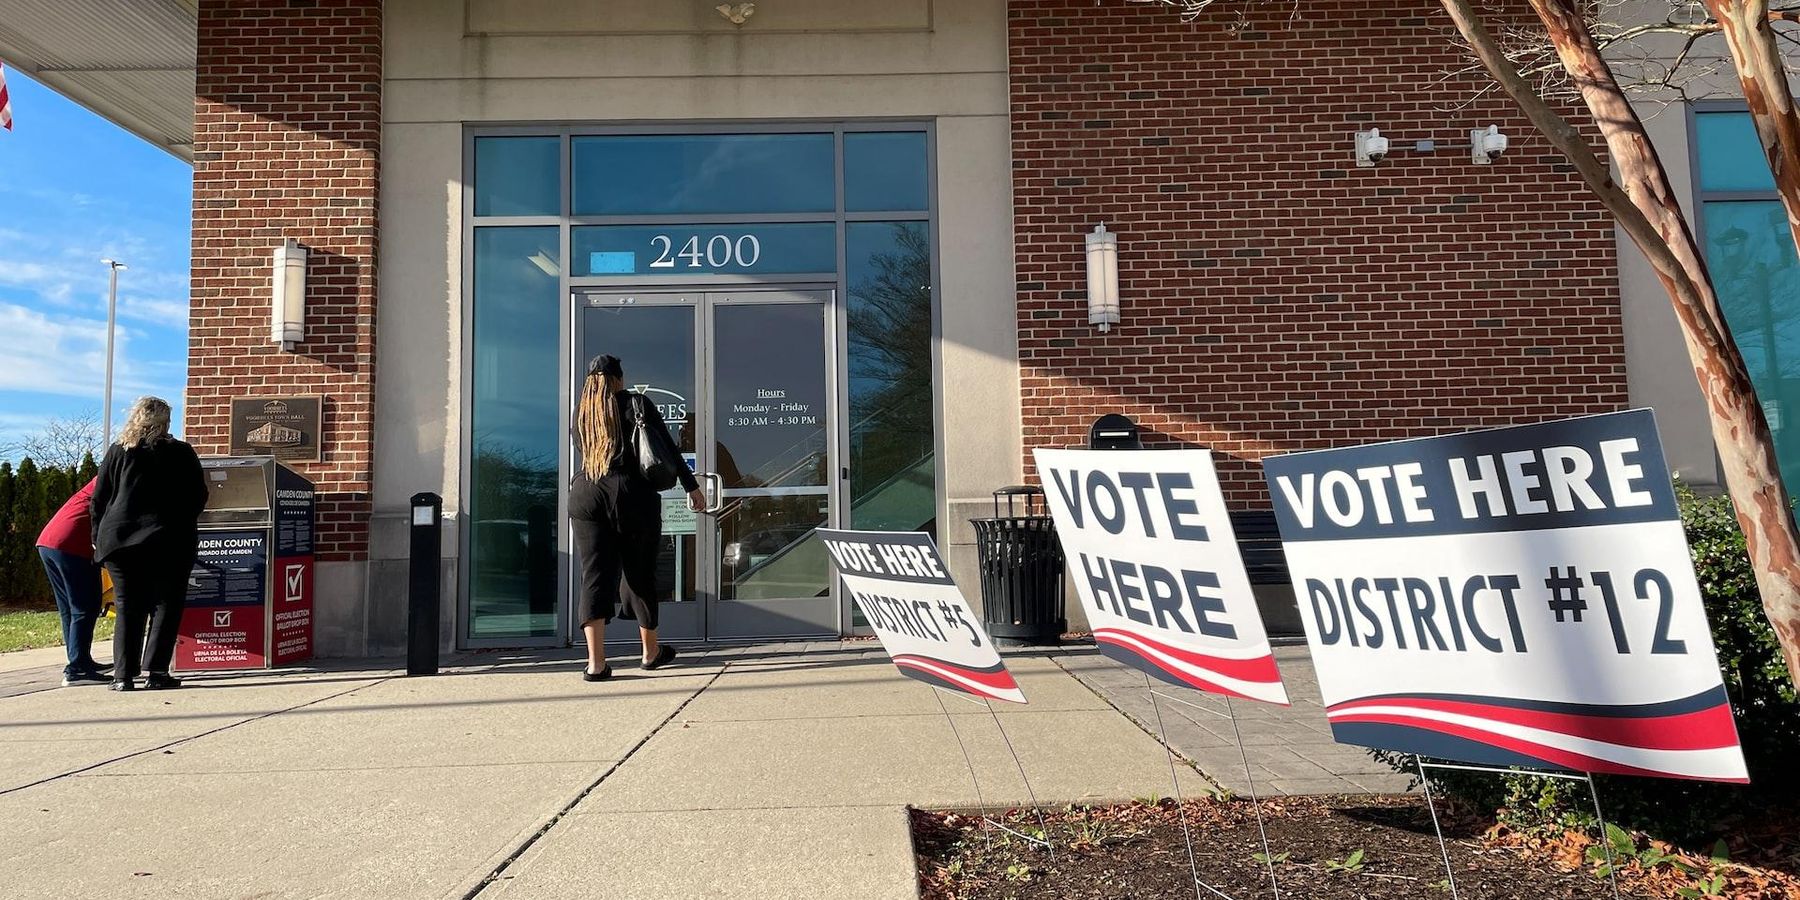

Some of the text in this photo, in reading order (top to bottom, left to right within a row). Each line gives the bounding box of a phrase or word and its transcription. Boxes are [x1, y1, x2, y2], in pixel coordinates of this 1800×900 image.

[650, 234, 760, 268] 2400
[733, 403, 771, 414] Monday
[780, 402, 809, 413] Friday
[757, 388, 786, 398] Hours
[728, 417, 750, 426] 8:30
[752, 417, 768, 426] AM
[777, 416, 799, 425] 4:30
[801, 416, 816, 425] PM
[1276, 437, 1654, 530] VOTE HERE
[1050, 467, 1211, 542] VOTE
[224, 538, 263, 548] COUNTY
[228, 548, 253, 556] CAMDEN
[824, 540, 946, 579] VOTE HERE
[1079, 552, 1239, 640] HERE
[1305, 565, 1689, 655] DISTRICT #12
[857, 591, 982, 648] DISTRICT #5
